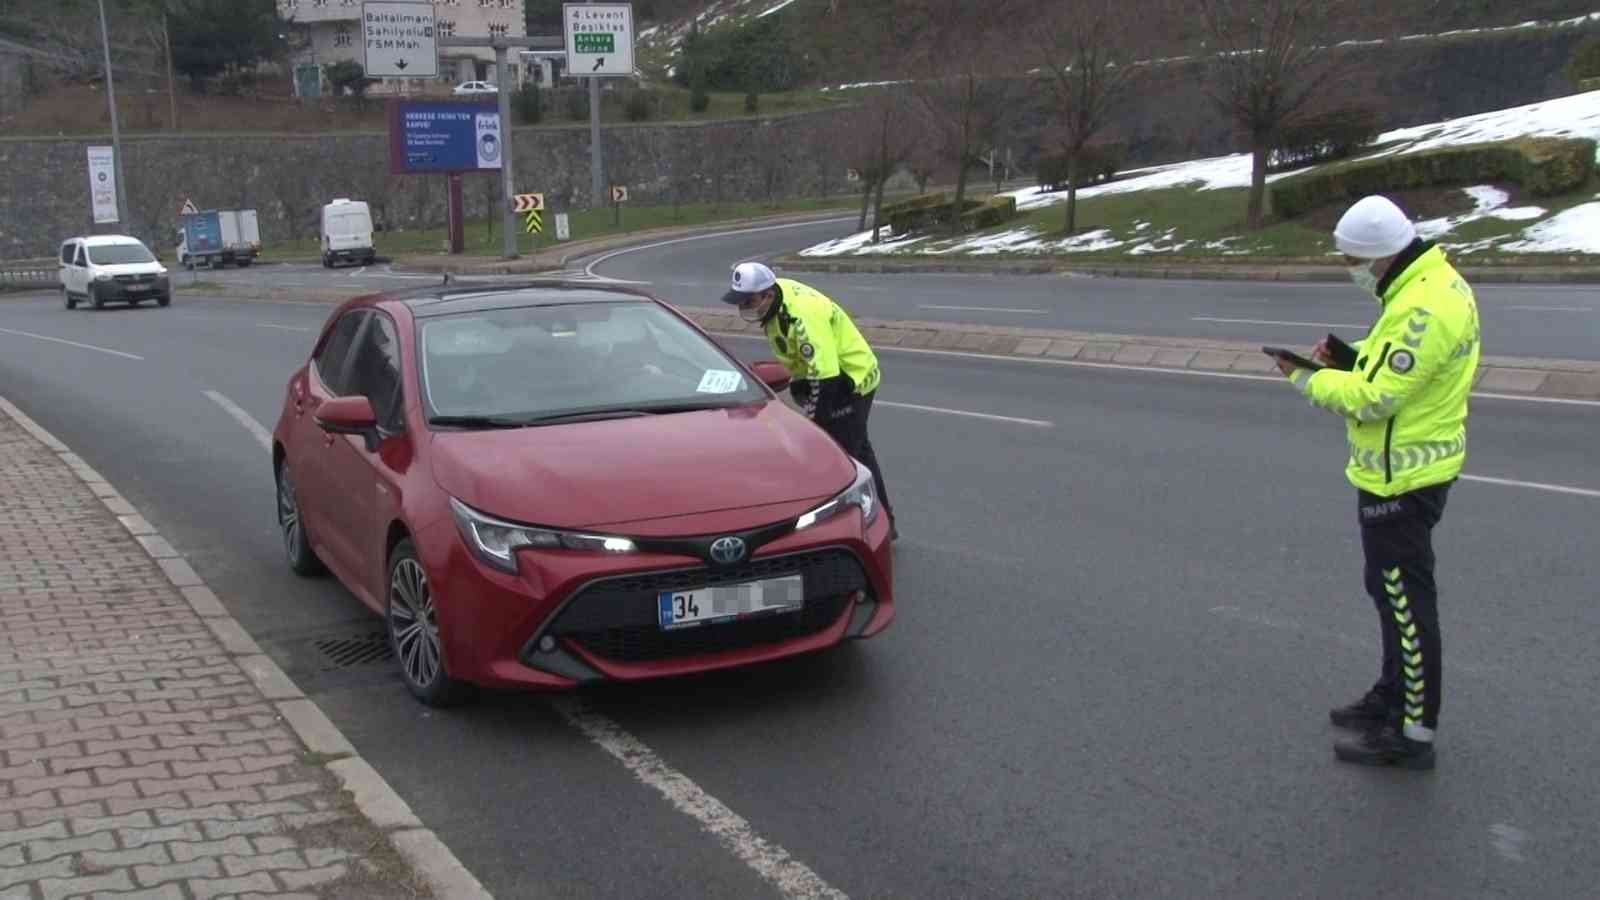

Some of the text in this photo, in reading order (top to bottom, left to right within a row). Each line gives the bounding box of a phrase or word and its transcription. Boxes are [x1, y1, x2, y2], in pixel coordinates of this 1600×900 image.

[367, 26, 423, 38] Sahilyolu
[577, 34, 611, 42] Ankara
[577, 44, 609, 52] Edirne
